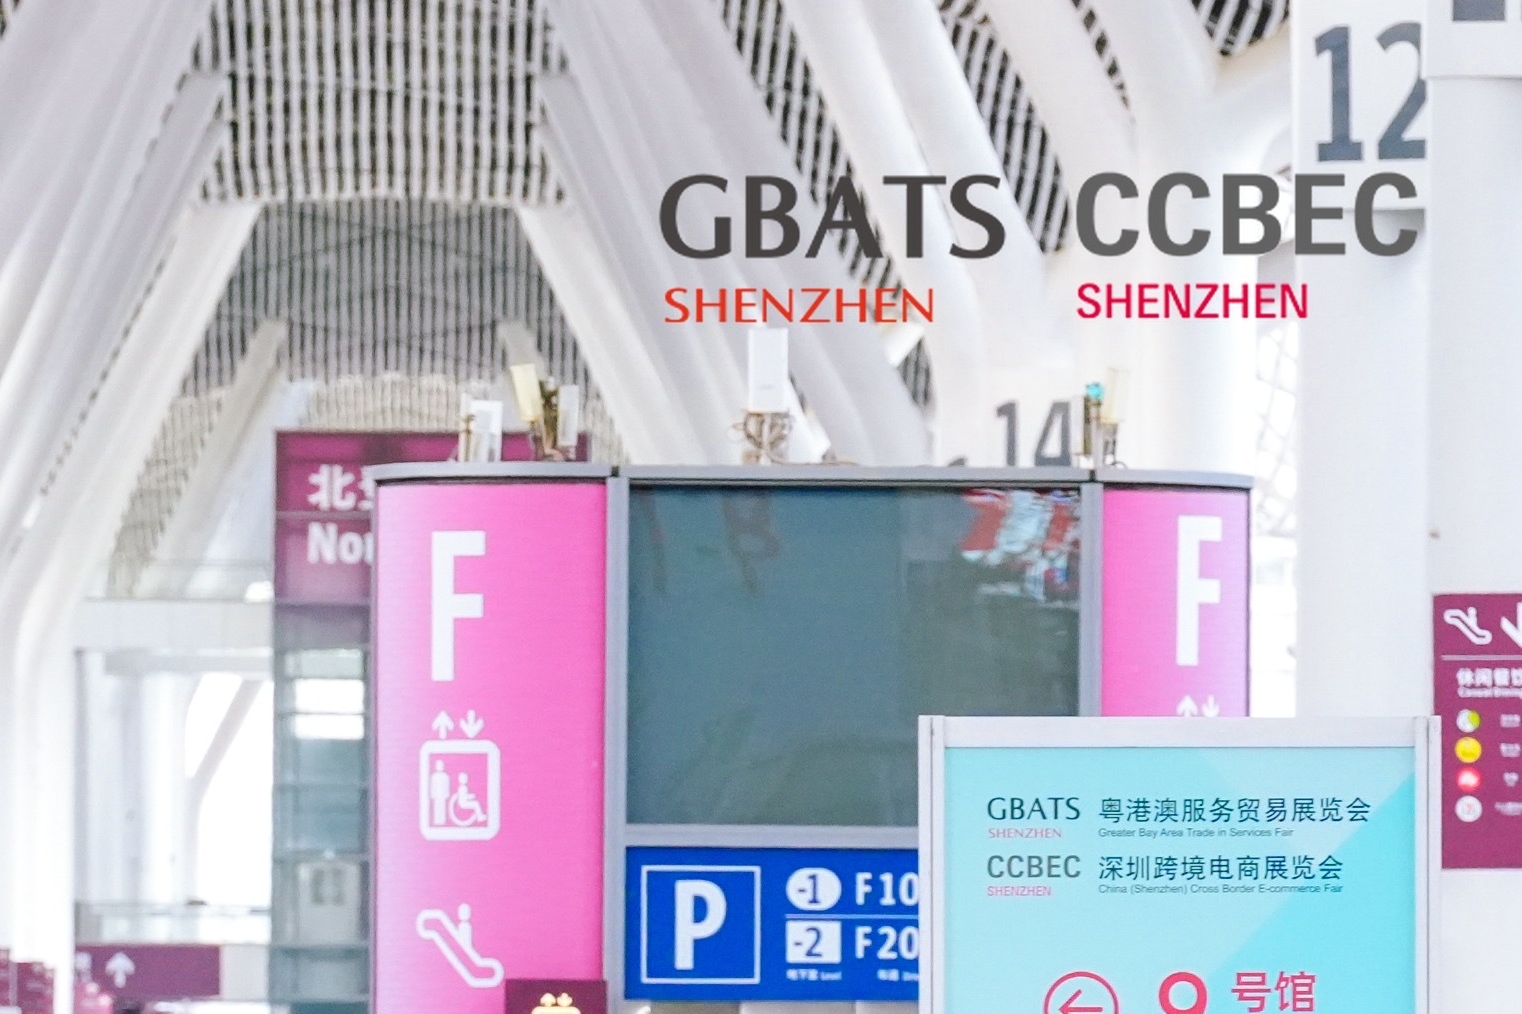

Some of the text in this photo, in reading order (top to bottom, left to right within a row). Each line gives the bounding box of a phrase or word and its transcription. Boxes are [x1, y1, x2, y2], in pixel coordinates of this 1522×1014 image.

[1315, 21, 1425, 162] 12
[1176, 515, 1223, 666] F
[430, 530, 486, 681] F
[987, 797, 1081, 820] GBATS
[1098, 797, 1371, 823] 粤港澳服务贸易展览会
[988, 827, 1062, 838] SHENZHEN
[1098, 827, 1294, 839] Greater Bay Area Trade in Services Fair
[987, 855, 1081, 879] CCBEC
[1098, 854, 1343, 881] 深圳跨境电商展览会
[987, 886, 1051, 896] SHENZHEN
[1098, 884, 1343, 895] China (Shenzhen) Cross Border E-commerce Fair
[674, 879, 727, 971] P
[1231, 971, 1316, 1013] 号馆
